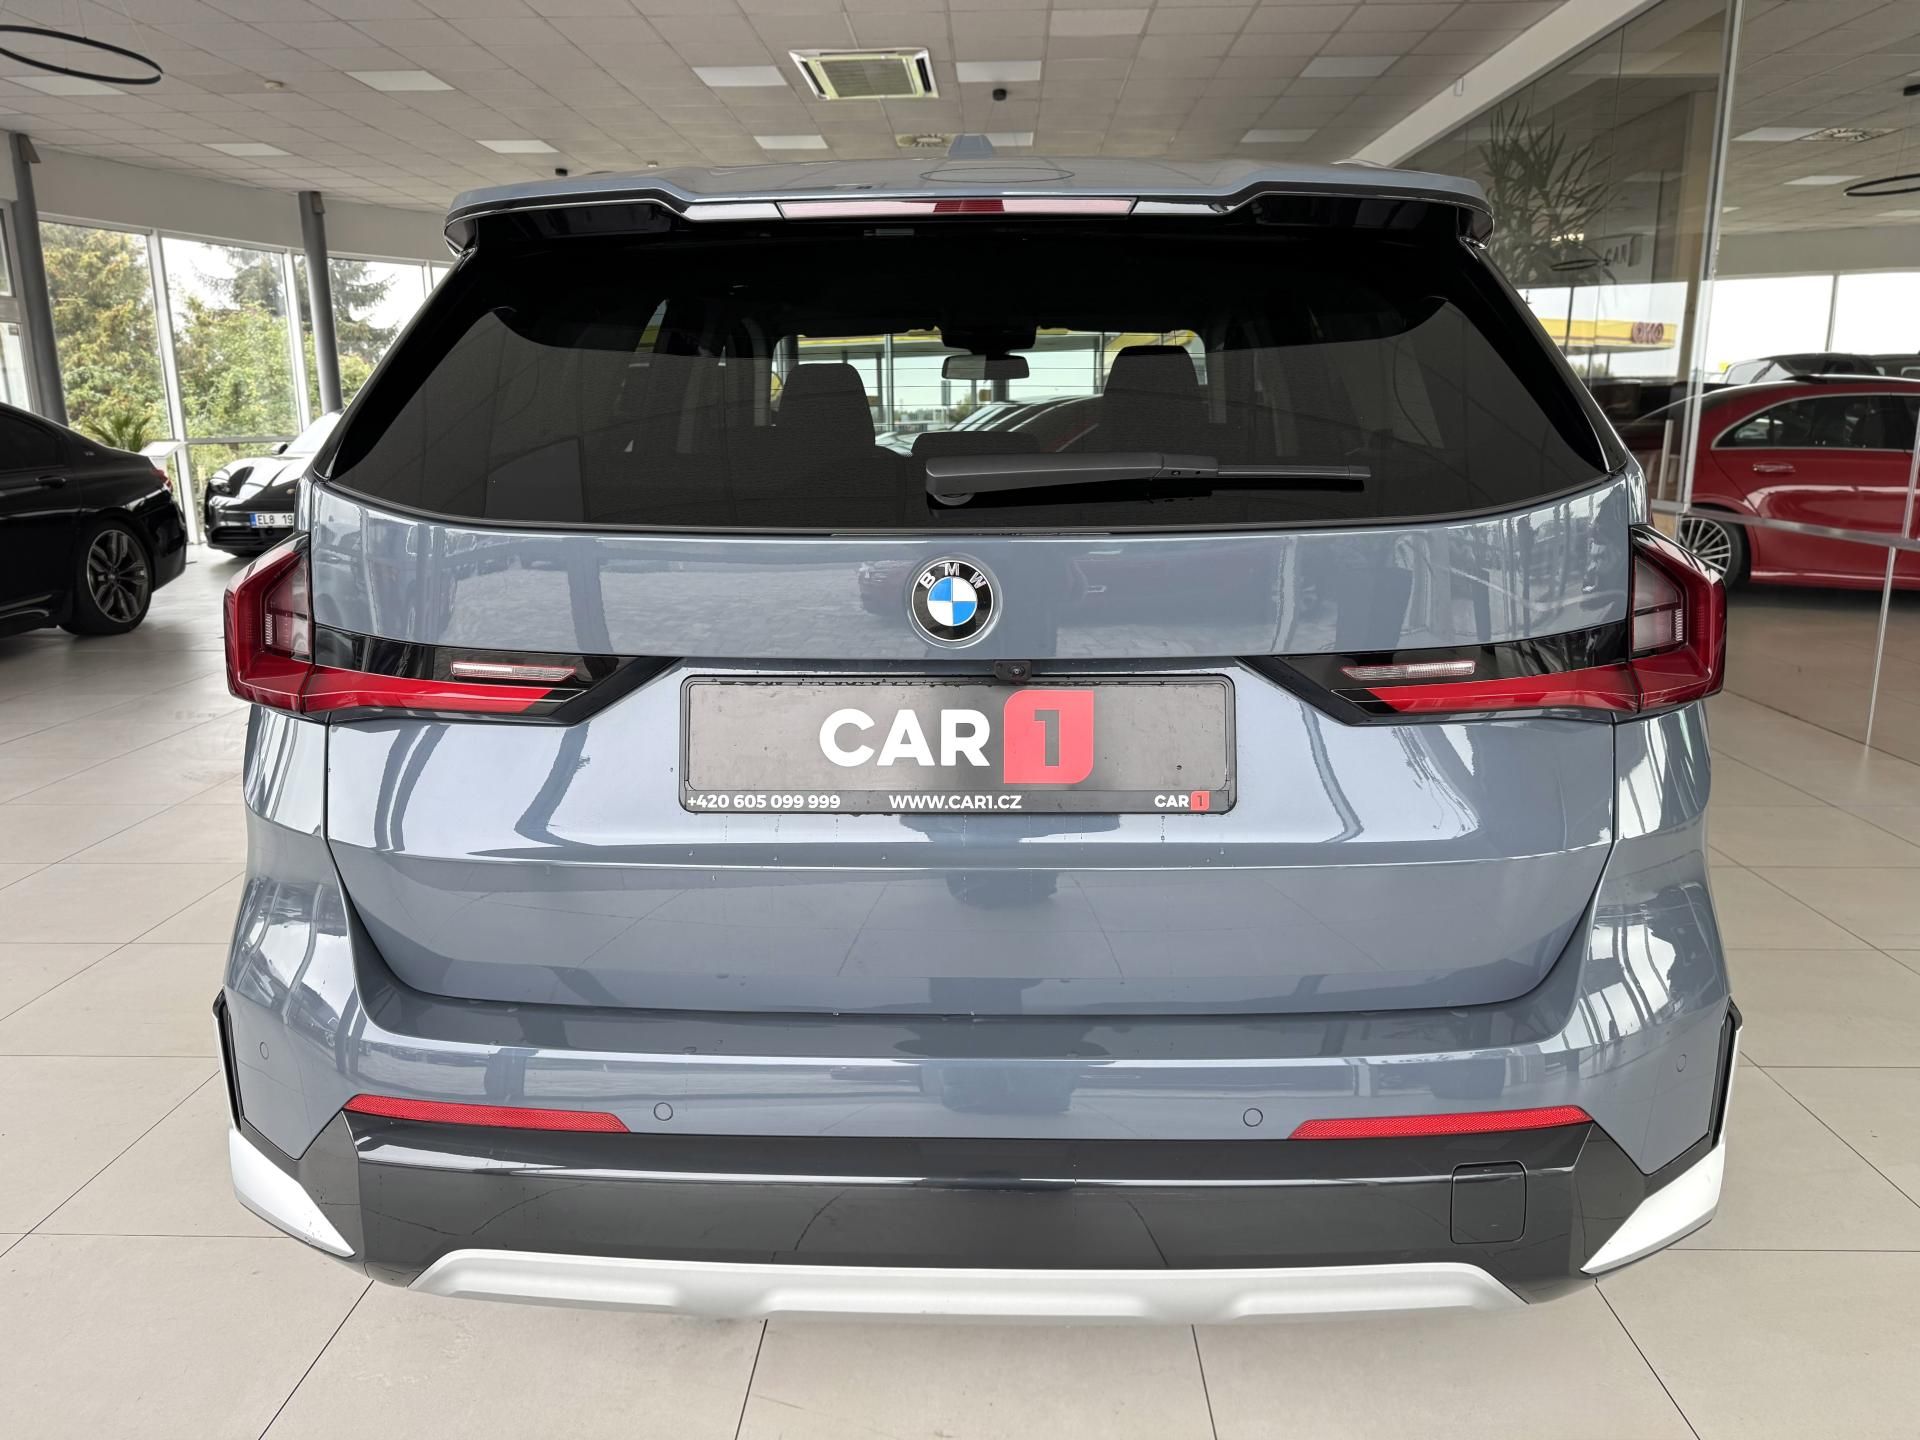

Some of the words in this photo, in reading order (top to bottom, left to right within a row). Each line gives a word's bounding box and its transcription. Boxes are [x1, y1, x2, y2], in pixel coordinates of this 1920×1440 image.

[919, 562, 987, 589] BMW
[819, 708, 991, 767] CAR
[687, 794, 729, 809] +420
[733, 794, 767, 809] 605
[770, 794, 804, 809] 099
[807, 794, 841, 809] 999
[889, 794, 1022, 809] WWW.CAR1.CZ
[1154, 795, 1189, 807] CAR
